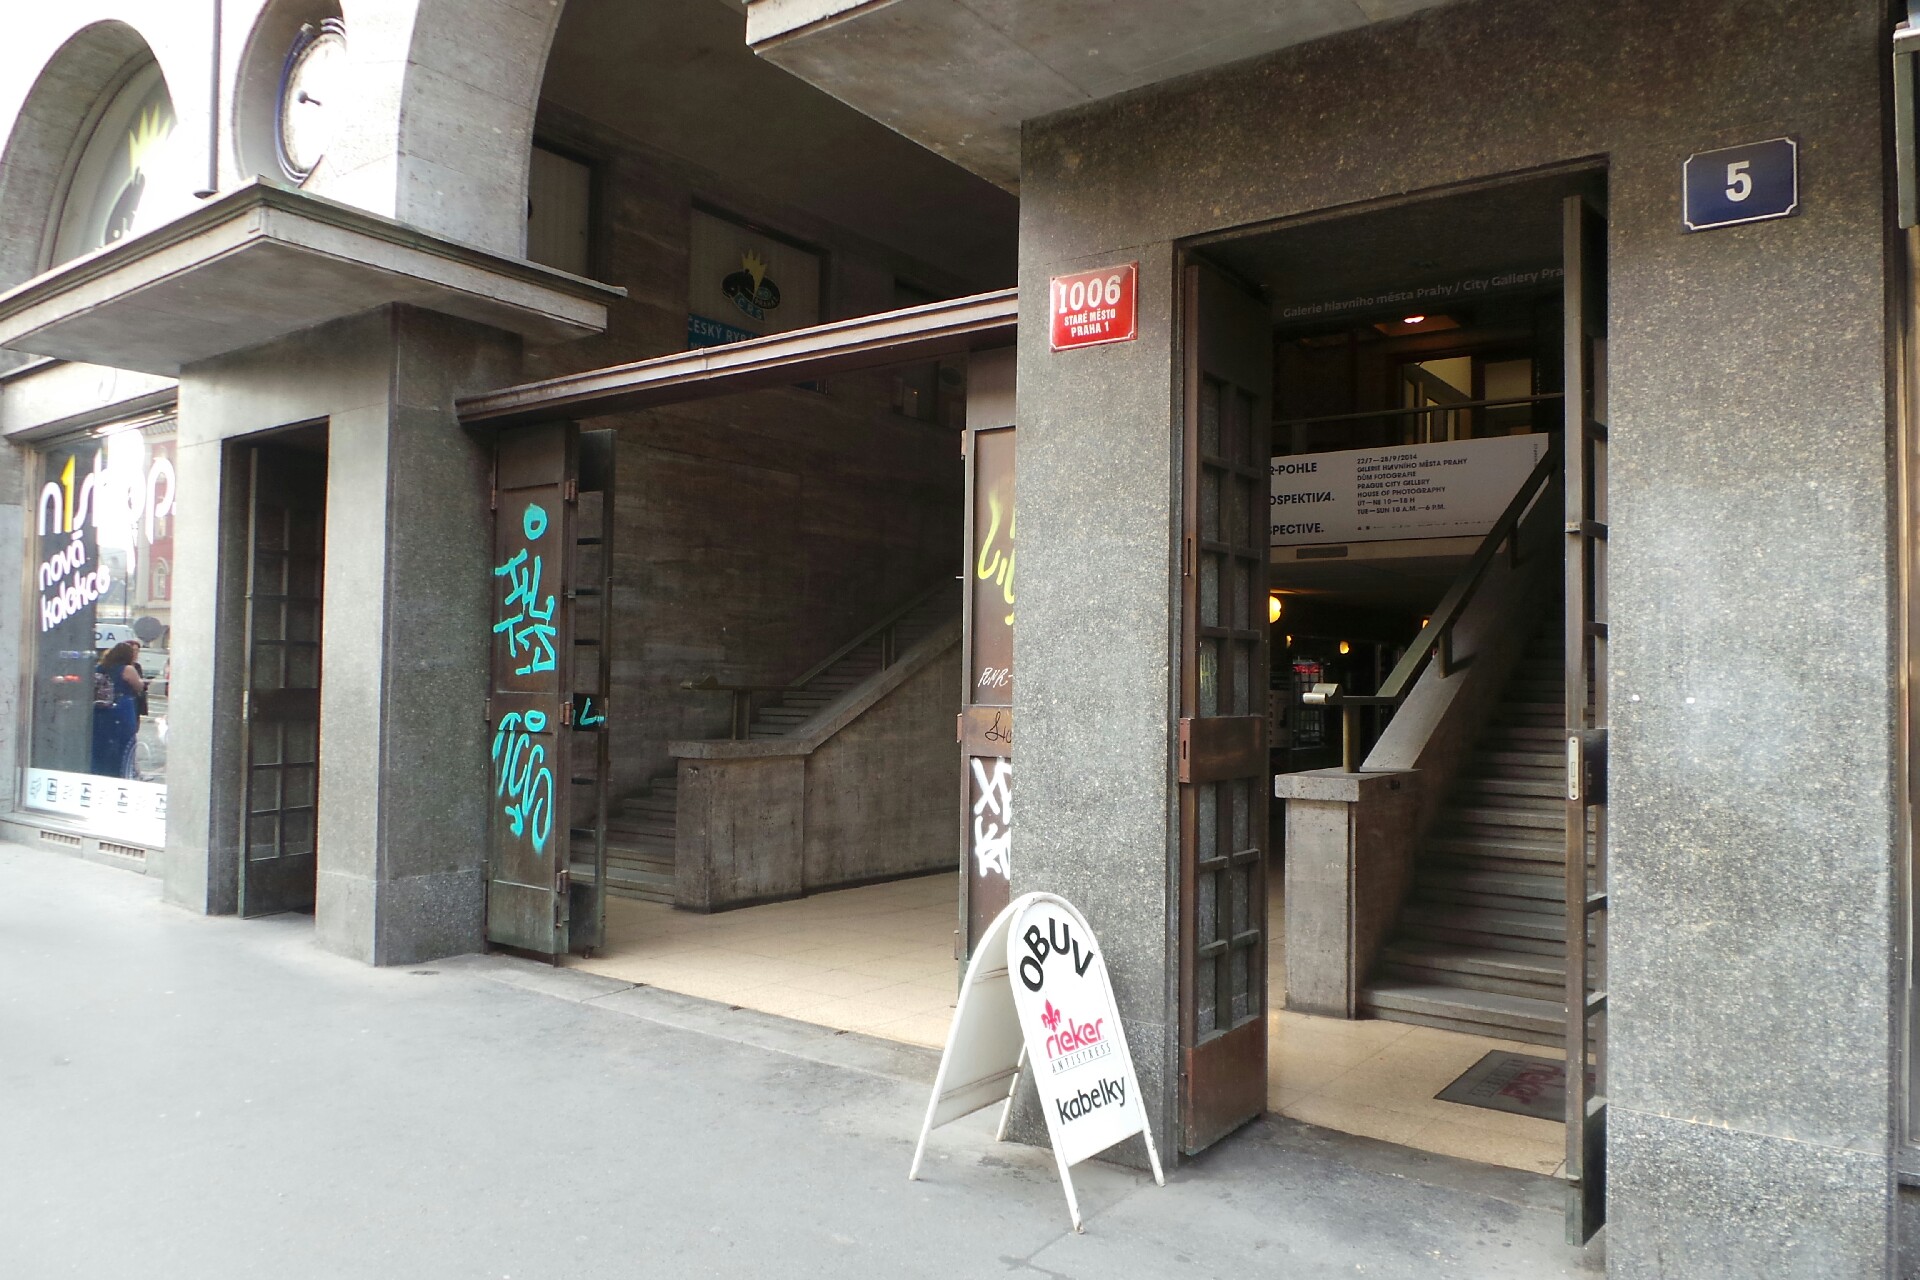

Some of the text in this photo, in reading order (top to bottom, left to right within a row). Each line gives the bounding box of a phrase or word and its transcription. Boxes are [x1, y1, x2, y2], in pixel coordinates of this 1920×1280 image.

[1725, 160, 1752, 202] 5
[1057, 275, 1121, 314] 1006
[1283, 303, 1322, 318] Galerie
[1376, 290, 1414, 304] města
[1417, 284, 1453, 298] Prahy
[1463, 279, 1490, 291] City
[1491, 271, 1540, 287] Gallery
[1064, 308, 1116, 326] STARÉ MĚSTO
[1071, 321, 1109, 337] PRAHA 1
[1357, 464, 1381, 473] GALERIE
[1374, 471, 1416, 480] FOTOGRAFIE
[1385, 480, 1401, 488] CITY
[1392, 486, 1446, 495] PHOTOGRAPHY
[40, 530, 86, 591] nová
[1019, 917, 1095, 992] OBUV
[1046, 1017, 1103, 1059] rieker
[1051, 1042, 1111, 1074] ANTISTRESS
[1055, 1076, 1125, 1125] kabelky
